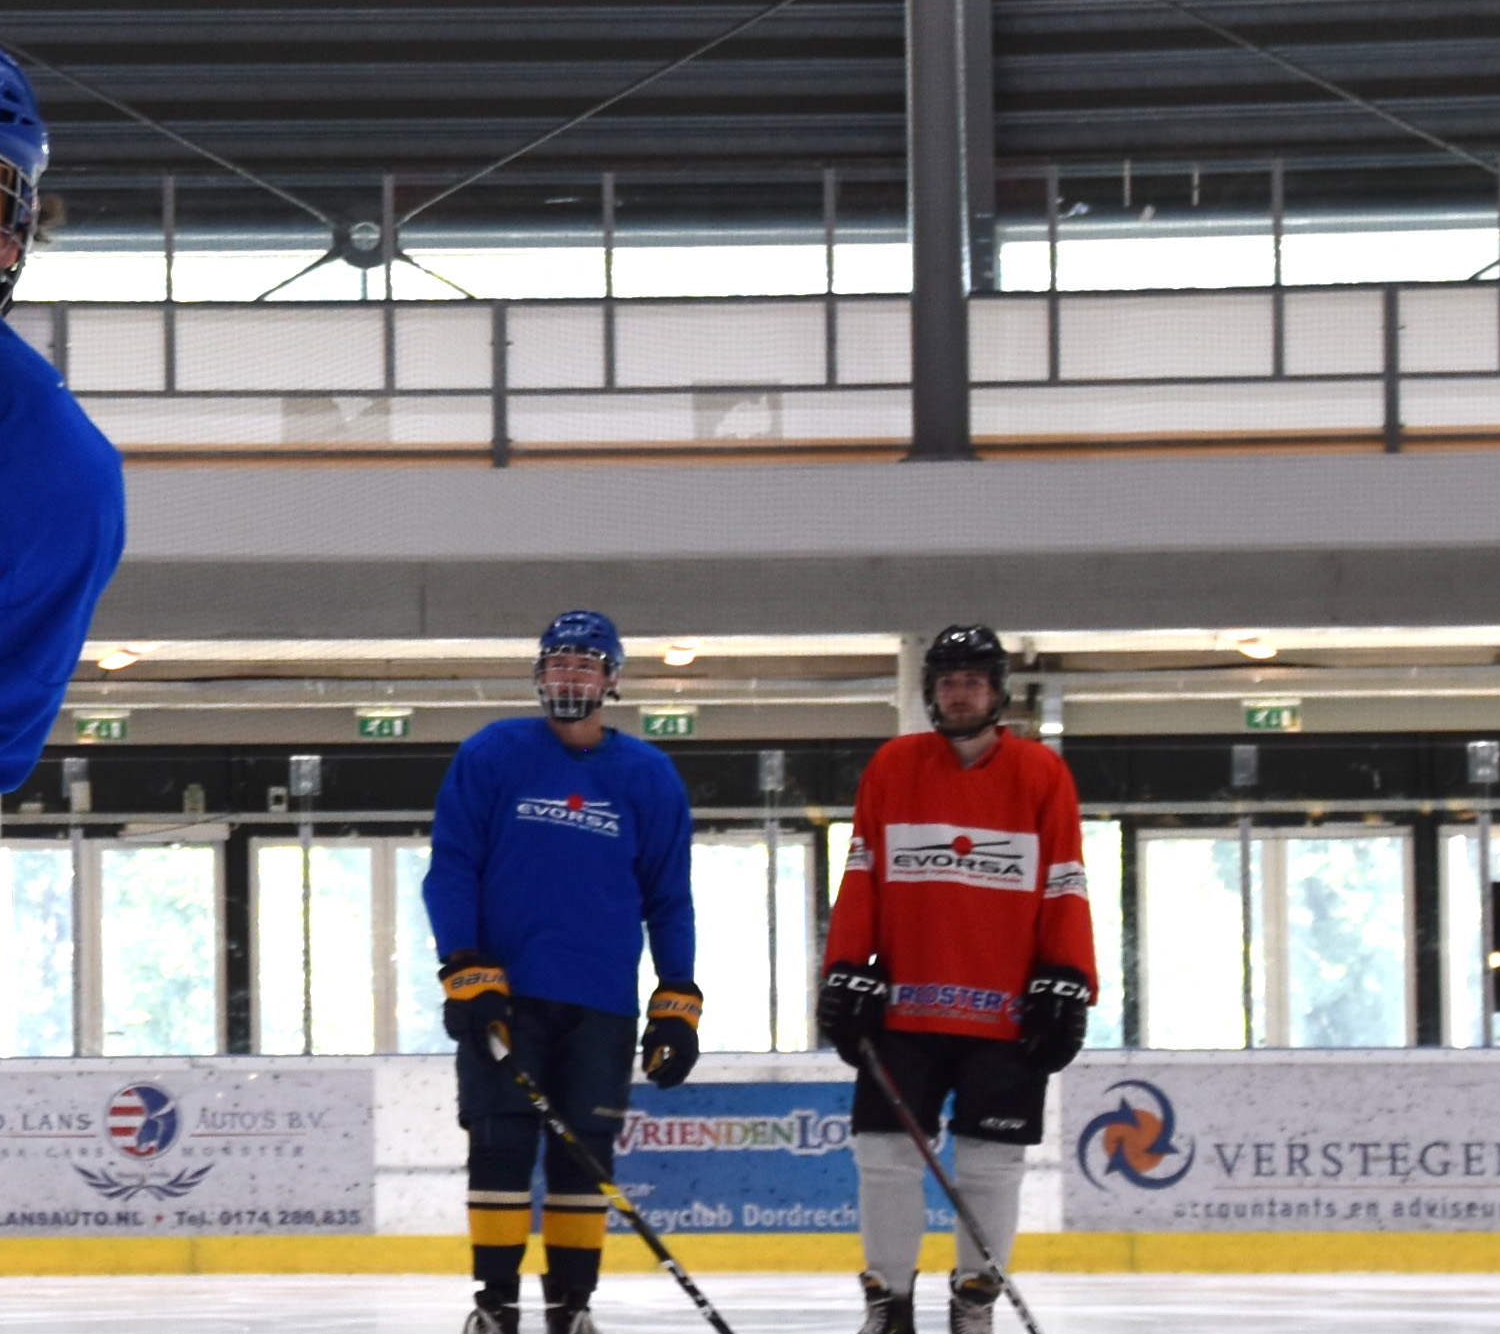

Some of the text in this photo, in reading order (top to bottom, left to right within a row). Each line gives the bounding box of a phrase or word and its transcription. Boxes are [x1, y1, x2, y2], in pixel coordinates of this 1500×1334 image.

[516, 802, 620, 833] EVORSA
[893, 854, 1024, 875] EVORSA
[22, 1114, 92, 1131] LANS
[1173, 1197, 1338, 1219] accountants
[1351, 1200, 1383, 1220] en
